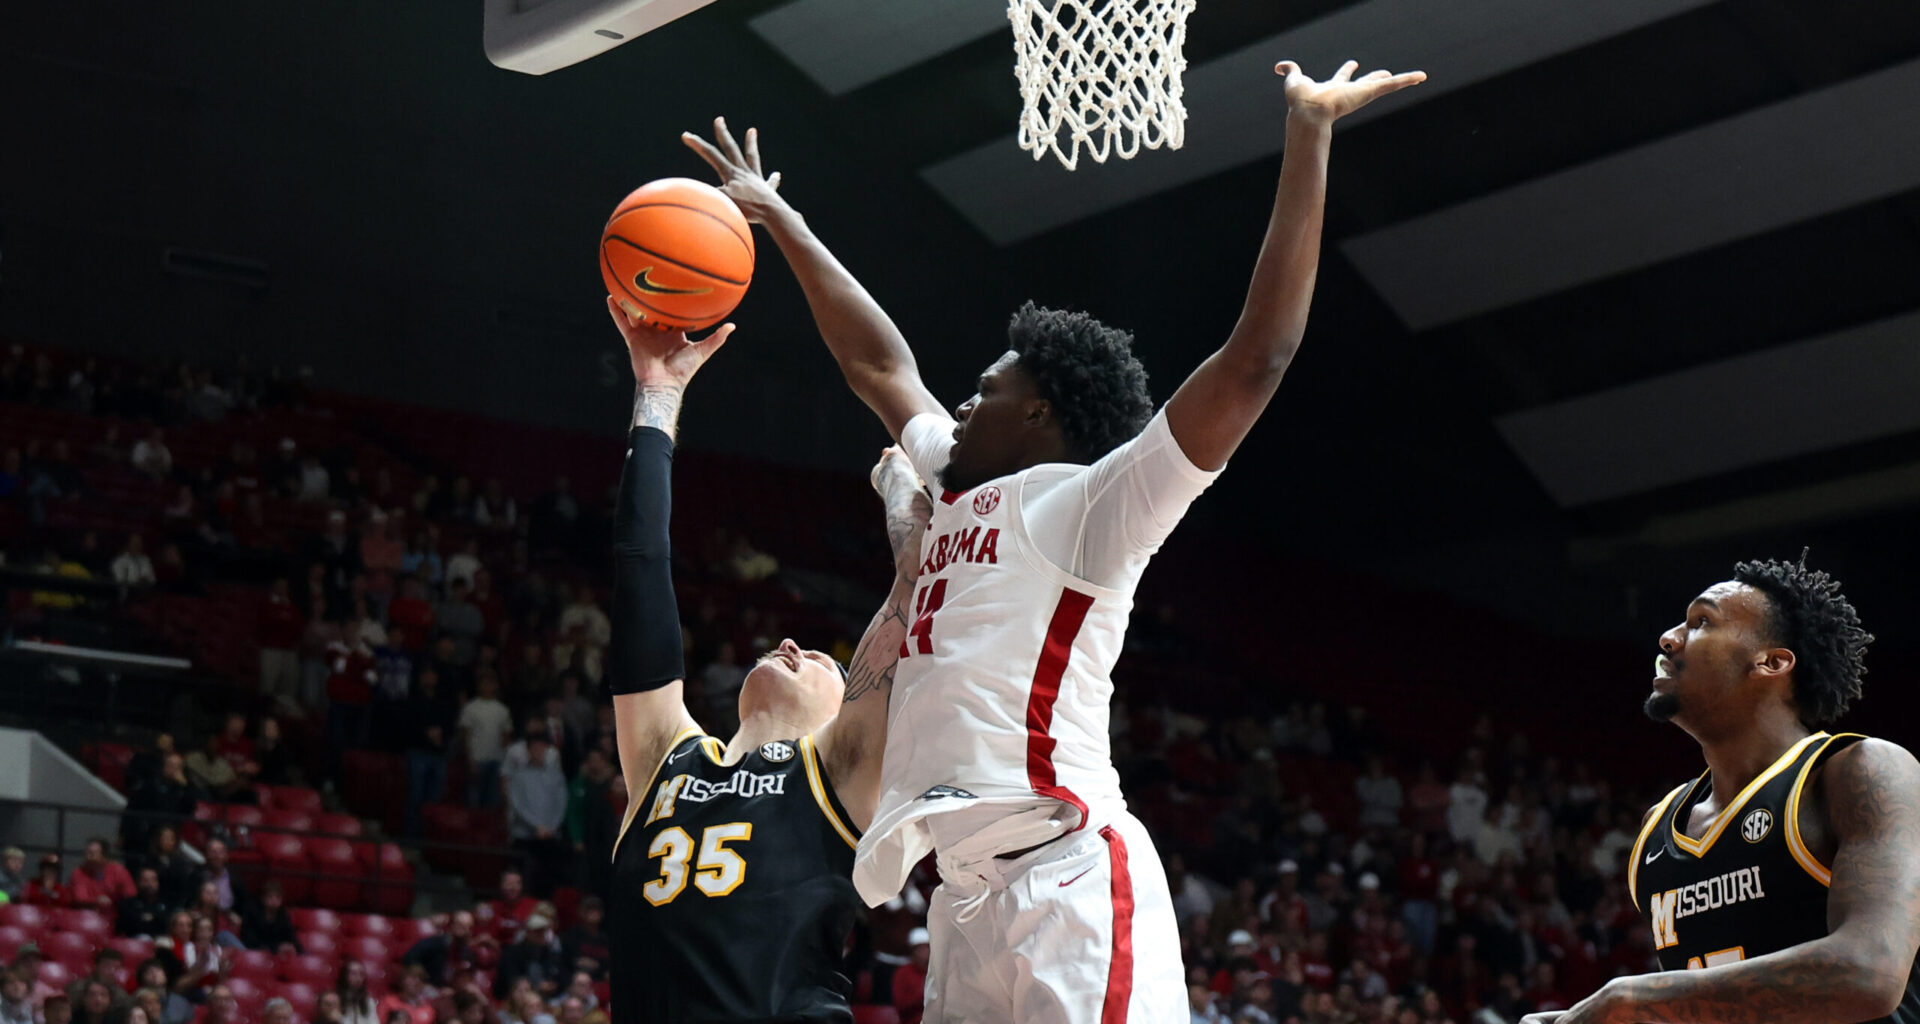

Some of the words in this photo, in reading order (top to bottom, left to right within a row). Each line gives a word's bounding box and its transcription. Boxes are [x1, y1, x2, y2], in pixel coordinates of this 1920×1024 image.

[974, 487, 1000, 514] SEC
[762, 741, 792, 761] SEC
[1744, 811, 1770, 841] SEC
[643, 822, 753, 907] 35
[1651, 866, 1765, 950] MISSOURI
